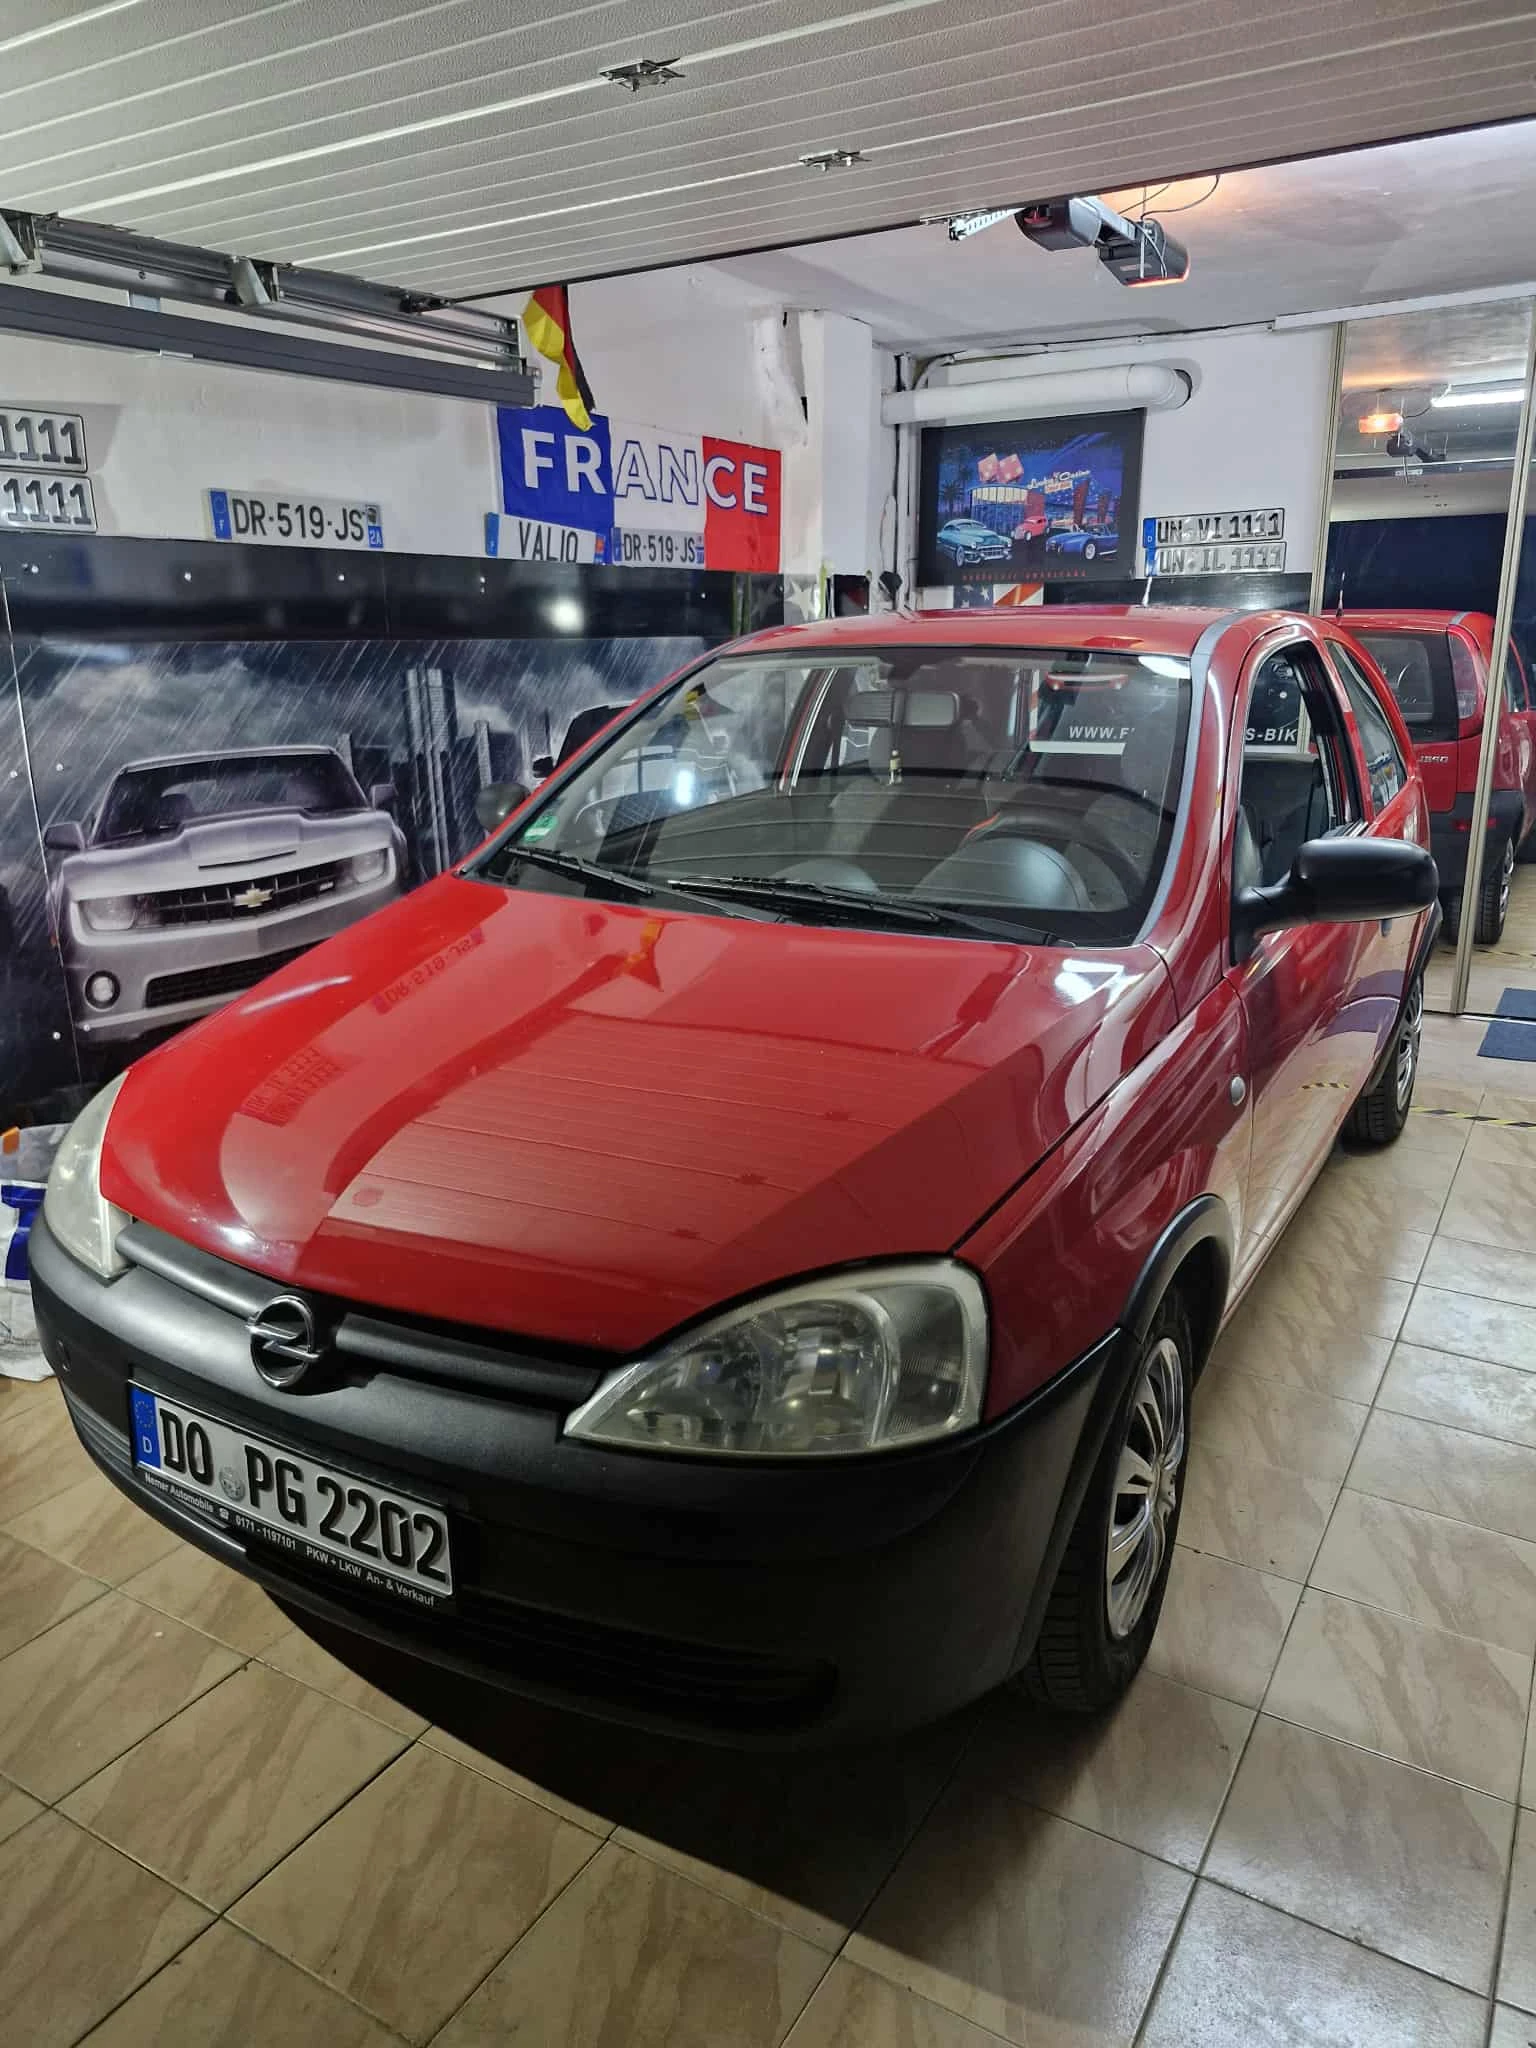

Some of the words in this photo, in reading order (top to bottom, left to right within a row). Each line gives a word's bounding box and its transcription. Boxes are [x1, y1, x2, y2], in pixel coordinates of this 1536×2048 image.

[521, 428, 769, 515] FRANCE
[1157, 520, 1182, 543] UN
[1198, 517, 1222, 539] VI
[1229, 512, 1280, 538] 1111
[1230, 546, 1282, 569] 1111
[1069, 726, 1135, 739] WWW.F
[143, 1436, 152, 1453] D
[160, 1407, 213, 1486] DO
[245, 1444, 306, 1528] PG
[317, 1475, 450, 1584] 2202
[170, 1485, 213, 1513] Automobile
[235, 1515, 255, 1532] 0171
[306, 1545, 328, 1564] PKW
[339, 1560, 362, 1577] LKW
[366, 1572, 384, 1585] An-
[386, 1580, 394, 1590] &
[396, 1583, 434, 1606] Verkauf
